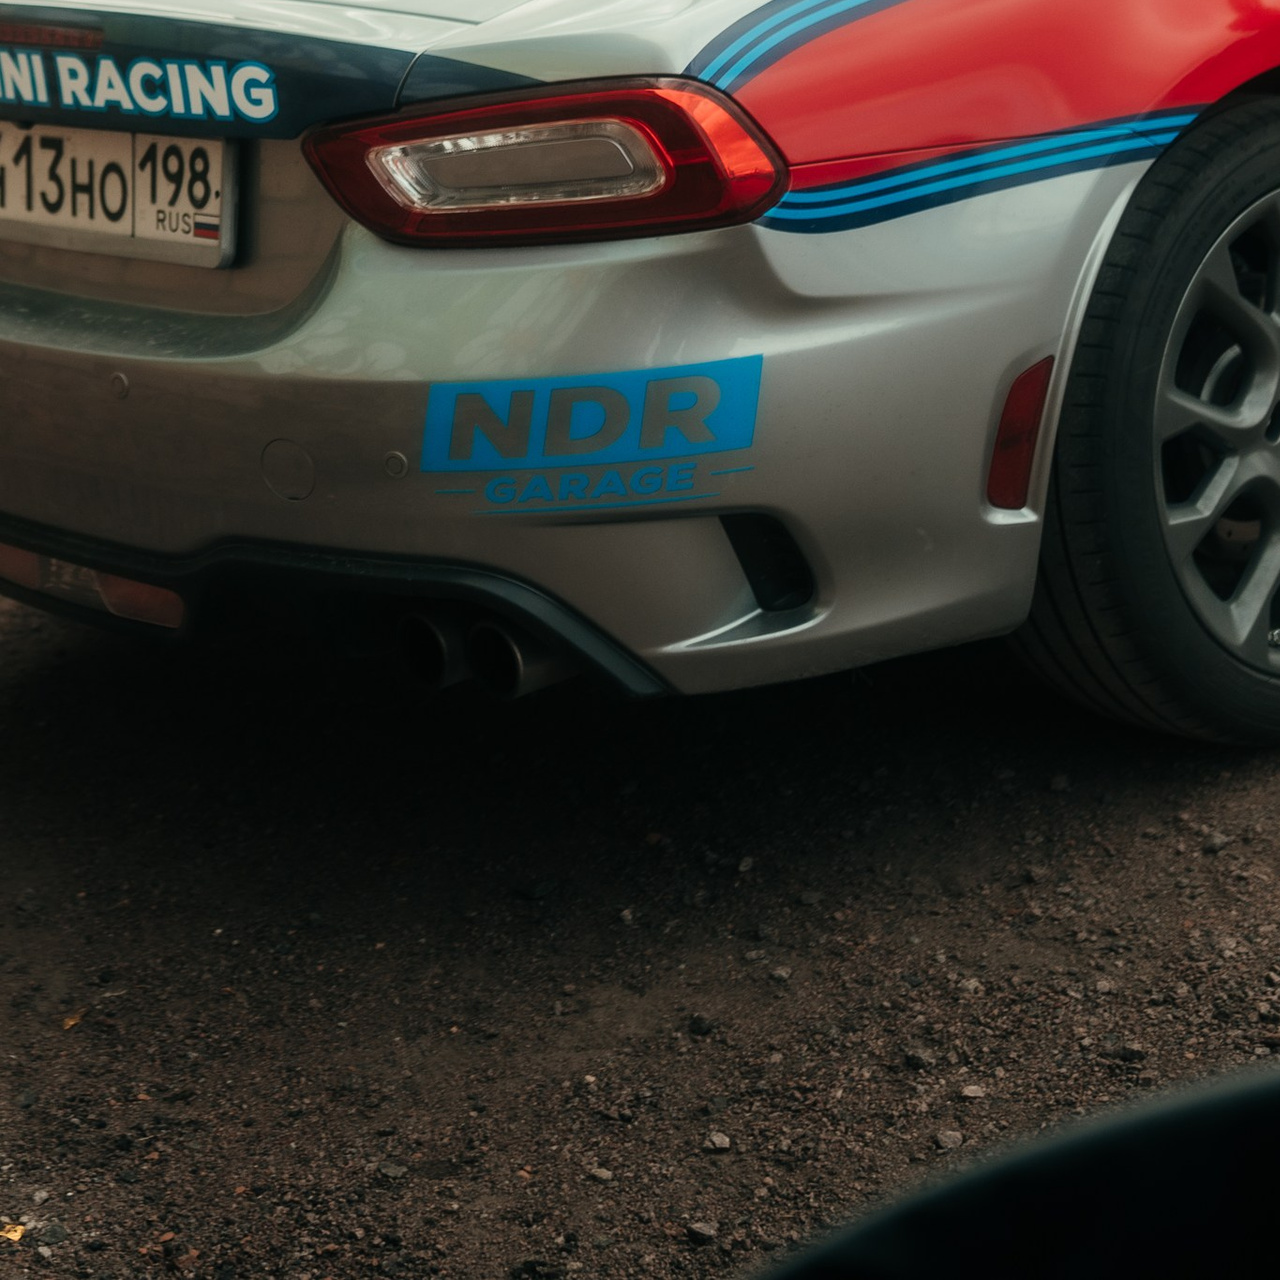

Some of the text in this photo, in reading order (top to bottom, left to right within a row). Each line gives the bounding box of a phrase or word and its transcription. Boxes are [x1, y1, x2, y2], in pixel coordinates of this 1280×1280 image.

[56, 54, 277, 120] RACING
[138, 141, 212, 210] 198
[156, 209, 192, 235] RUS
[448, 375, 721, 461] NDR
[483, 462, 697, 504] GARAGE
